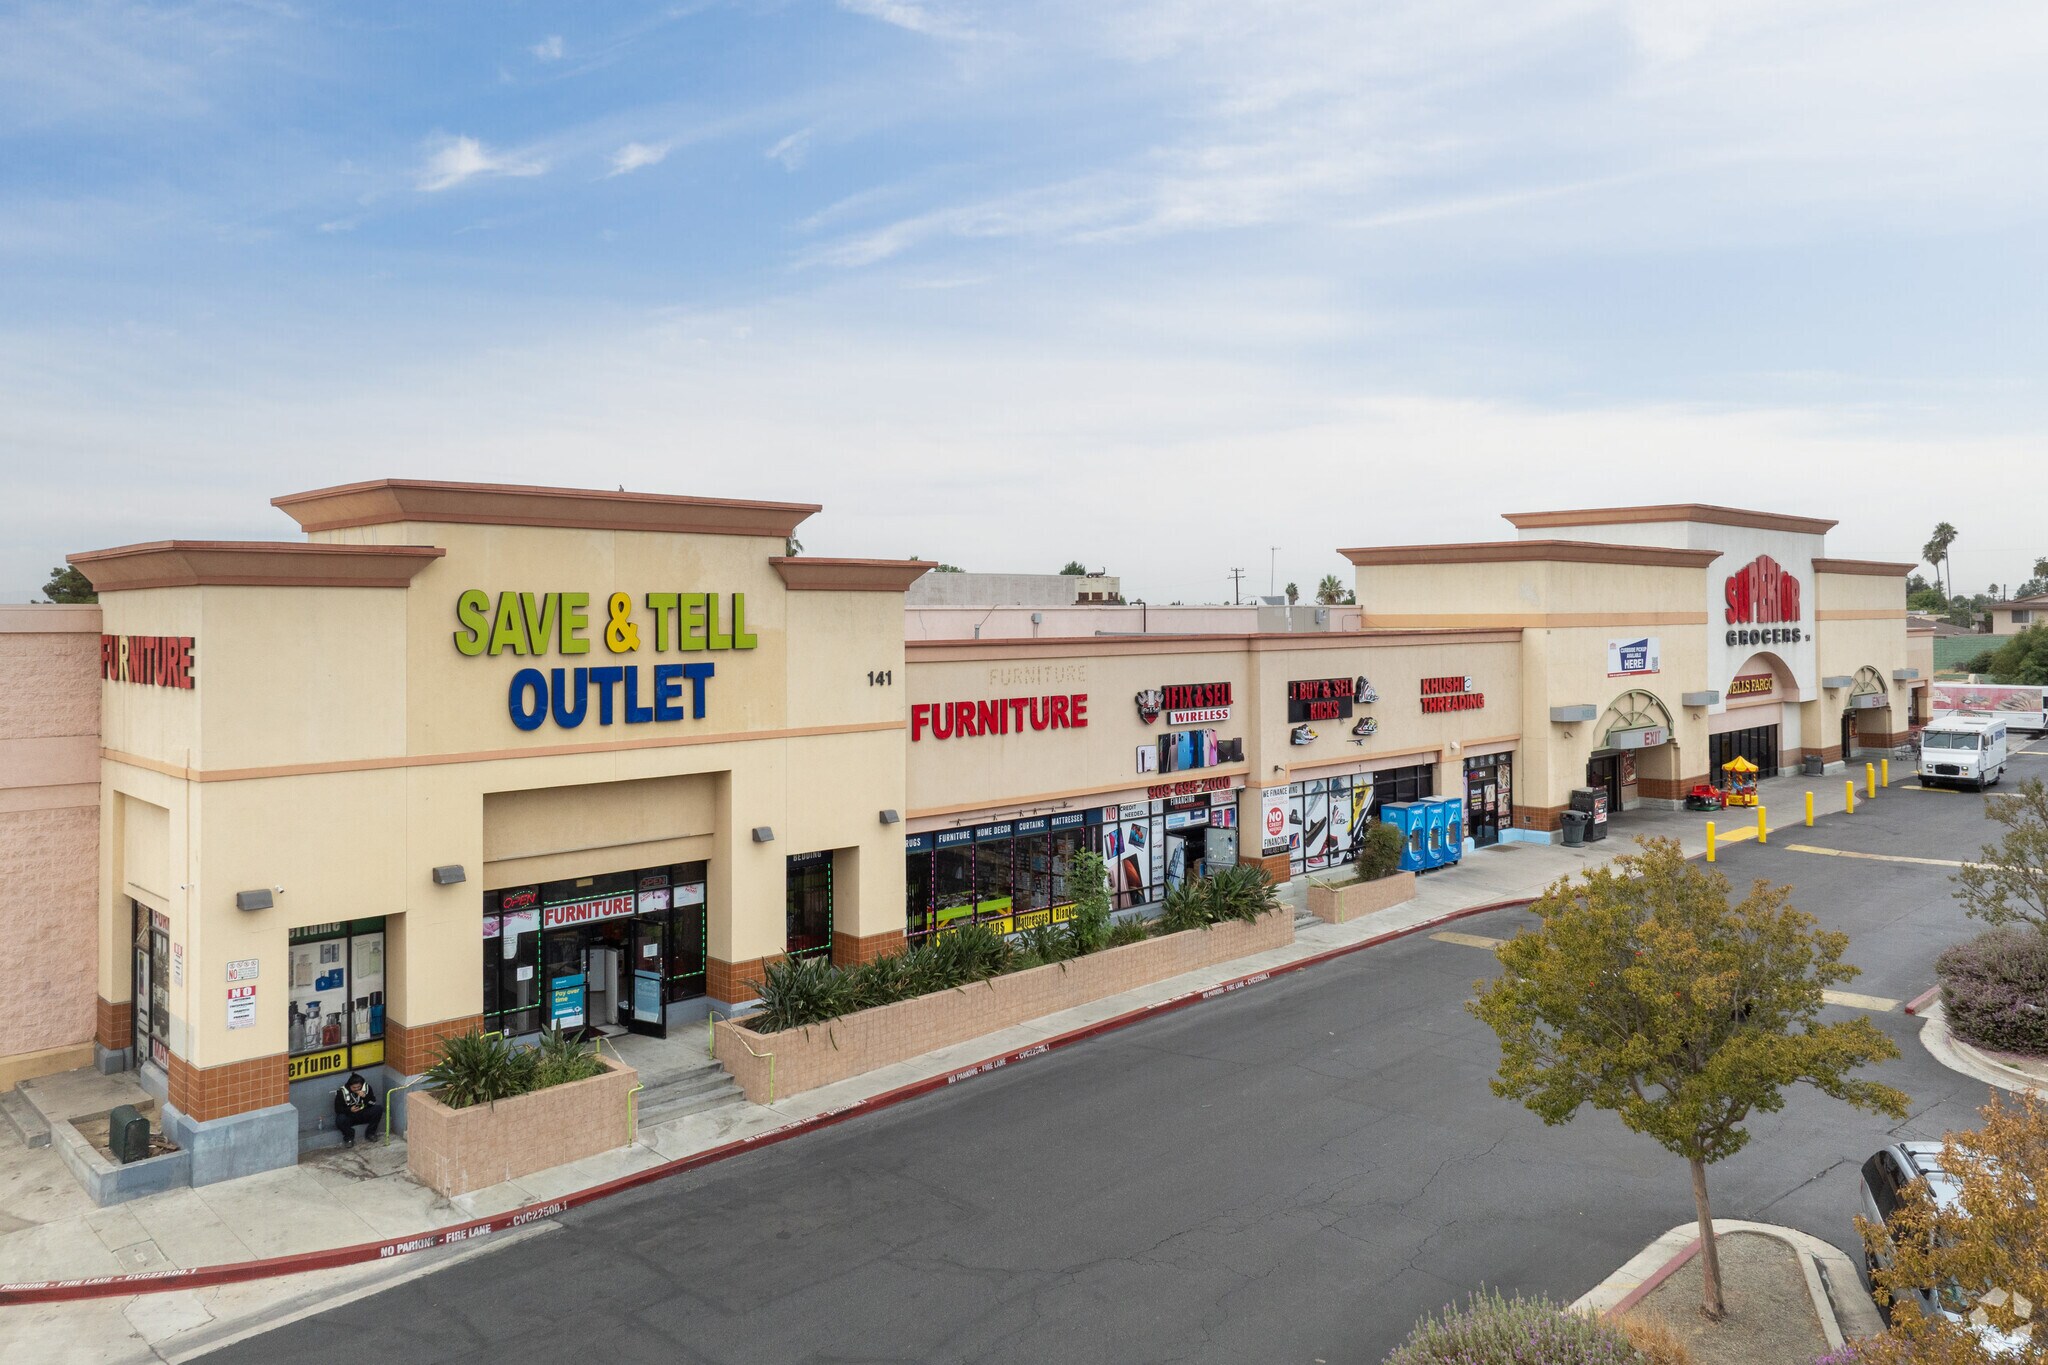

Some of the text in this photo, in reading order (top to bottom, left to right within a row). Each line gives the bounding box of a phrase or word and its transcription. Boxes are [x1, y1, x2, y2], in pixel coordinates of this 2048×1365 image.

[1725, 554, 1801, 625] SUPERIOR
[453, 589, 758, 656] SAVE & TELL
[1725, 628, 1802, 647] GROCERS
[101, 634, 196, 690] FURNITURE
[1624, 658, 1644, 669] HERE!
[867, 669, 893, 687] 141
[1421, 677, 1465, 695] KHUSHI
[1751, 678, 1773, 692] FARGO
[508, 662, 715, 732] OUTLET
[1206, 683, 1234, 706] SELL
[1300, 682, 1320, 700] BUY
[1322, 680, 1331, 699] &
[1334, 679, 1355, 697] SELL
[1310, 701, 1340, 721] KICKS
[1420, 693, 1485, 714] THREADING
[911, 694, 1088, 742] FURNITURE
[1174, 709, 1229, 723] WIRELESS
[1644, 730, 1661, 746] EXIT
[1148, 776, 1231, 800] 909-695-2000
[1270, 787, 1288, 797] FINANCE
[1120, 804, 1137, 812] CREDIT
[1170, 795, 1195, 806] FINANCING
[1051, 814, 1083, 826] MATTRESSES
[1106, 807, 1116, 821] NO
[1269, 810, 1282, 822] NO
[976, 825, 1012, 837] HOME DECOR
[1018, 820, 1045, 831] CURTAINS
[905, 838, 921, 848] RUGS
[938, 831, 971, 843] FURNITURE
[1264, 836, 1288, 848] FINANCING
[503, 893, 537, 909] OPEN
[544, 896, 633, 927] FURNITURE
[1016, 912, 1050, 931] Mattresses
[228, 969, 238, 980] NO
[231, 987, 252, 998] NO
[288, 1053, 341, 1078] erfume
[948, 1075, 956, 1084] NO
[956, 1066, 979, 1081] PARKING
[982, 1061, 994, 1072] FIRE
[994, 1057, 1007, 1068] LANE
[380, 1245, 395, 1258] NO
[396, 1235, 437, 1254] PARKING
[446, 1229, 467, 1244] FIRE
[468, 1223, 492, 1240] LANE
[513, 1200, 568, 1227] CVC22500.1
[0, 1282, 50, 1291] PARKING
[57, 1278, 84, 1287] FIRE
[84, 1276, 114, 1285] LANE
[126, 1268, 197, 1281] CVC22500.1
